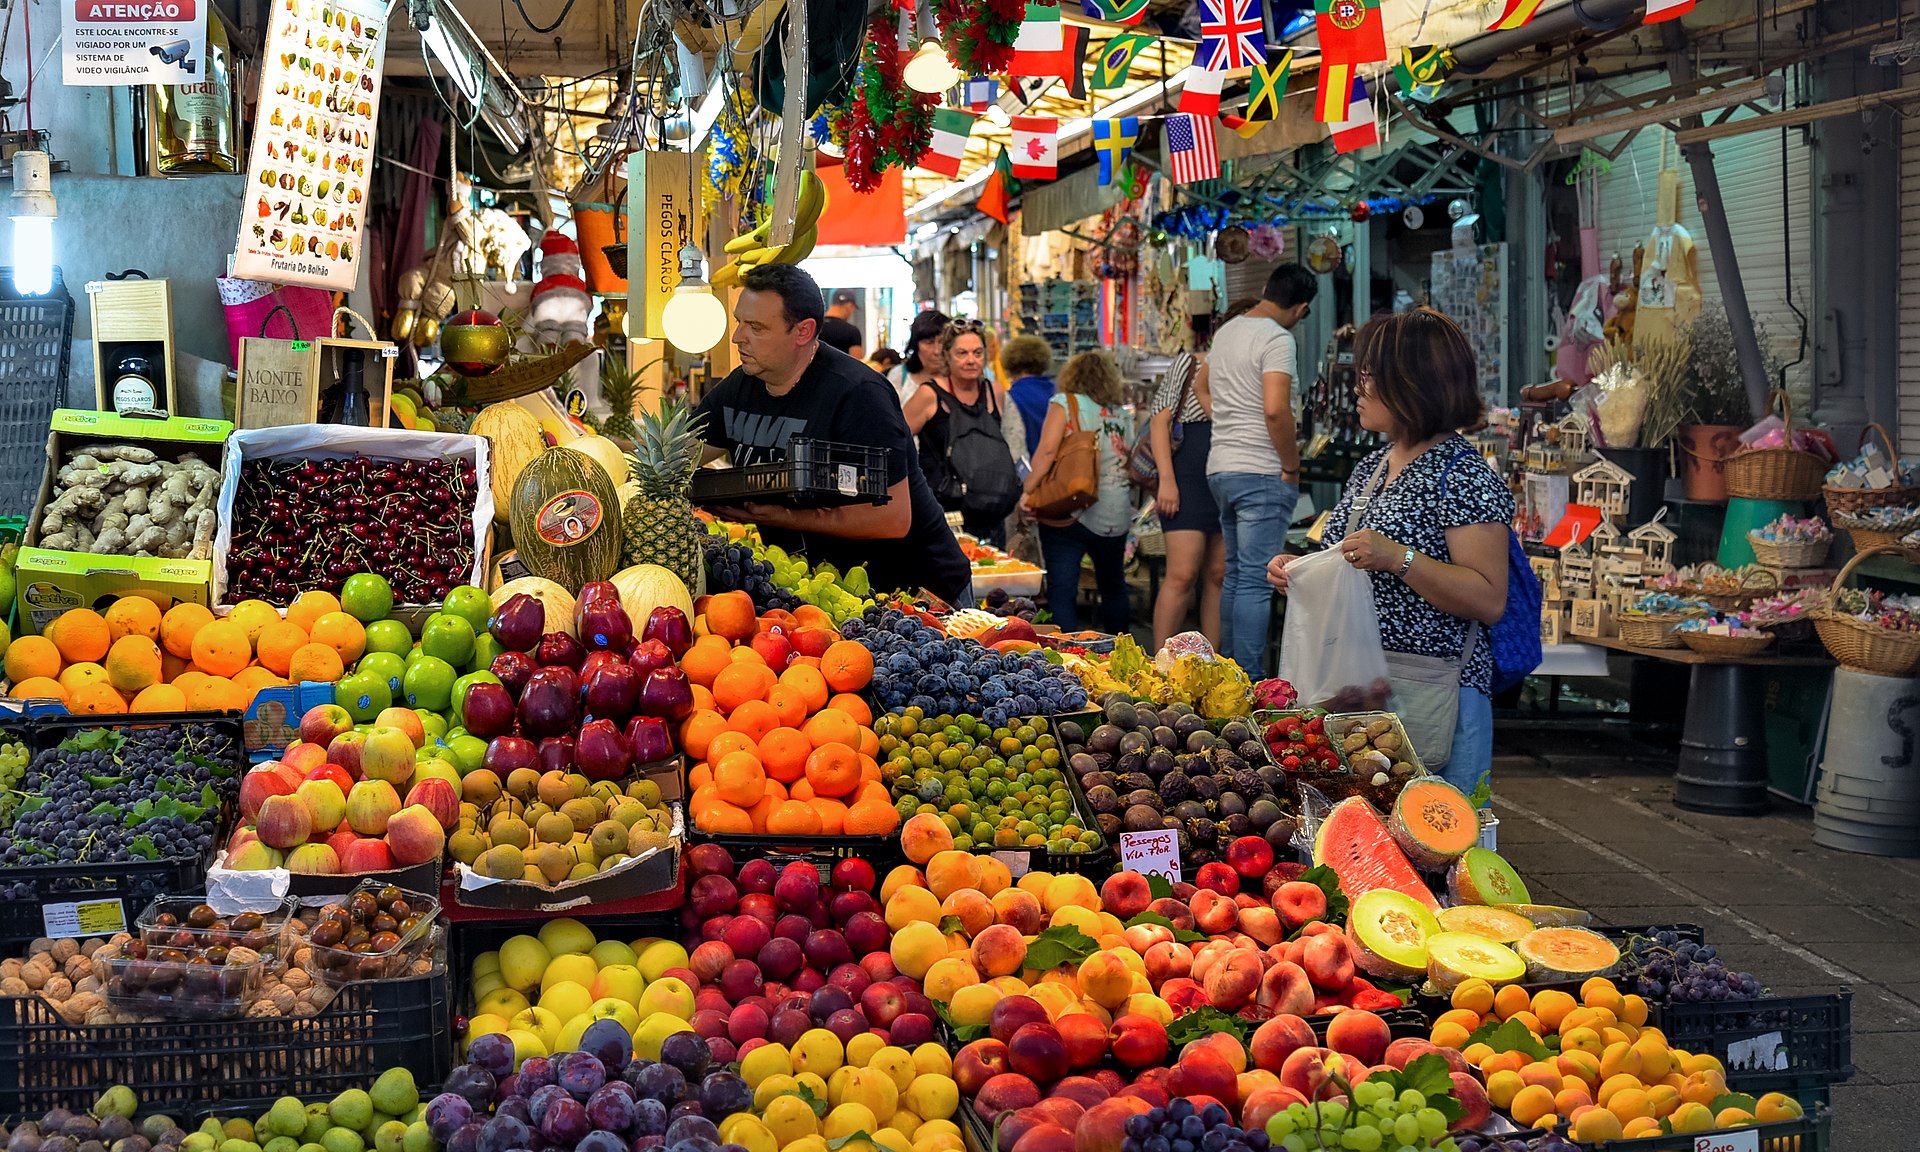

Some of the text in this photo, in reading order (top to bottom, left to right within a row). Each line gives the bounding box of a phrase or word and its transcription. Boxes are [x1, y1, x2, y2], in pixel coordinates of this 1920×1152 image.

[89, 2, 180, 20] ATENÇÃO
[124, 28, 179, 36] ENCONTRE-SE
[104, 65, 149, 74] VIGILÂNCIA
[660, 194, 673, 293] PEGOS CLAROS
[271, 259, 329, 276] Frutaria Do Bolhão
[246, 369, 303, 387] MONTE
[250, 388, 298, 405] BAIXO
[62, 414, 97, 424] nativa
[185, 424, 220, 432] nativa
[31, 594, 79, 605] nativa
[1121, 834, 1172, 848] Pessegos
